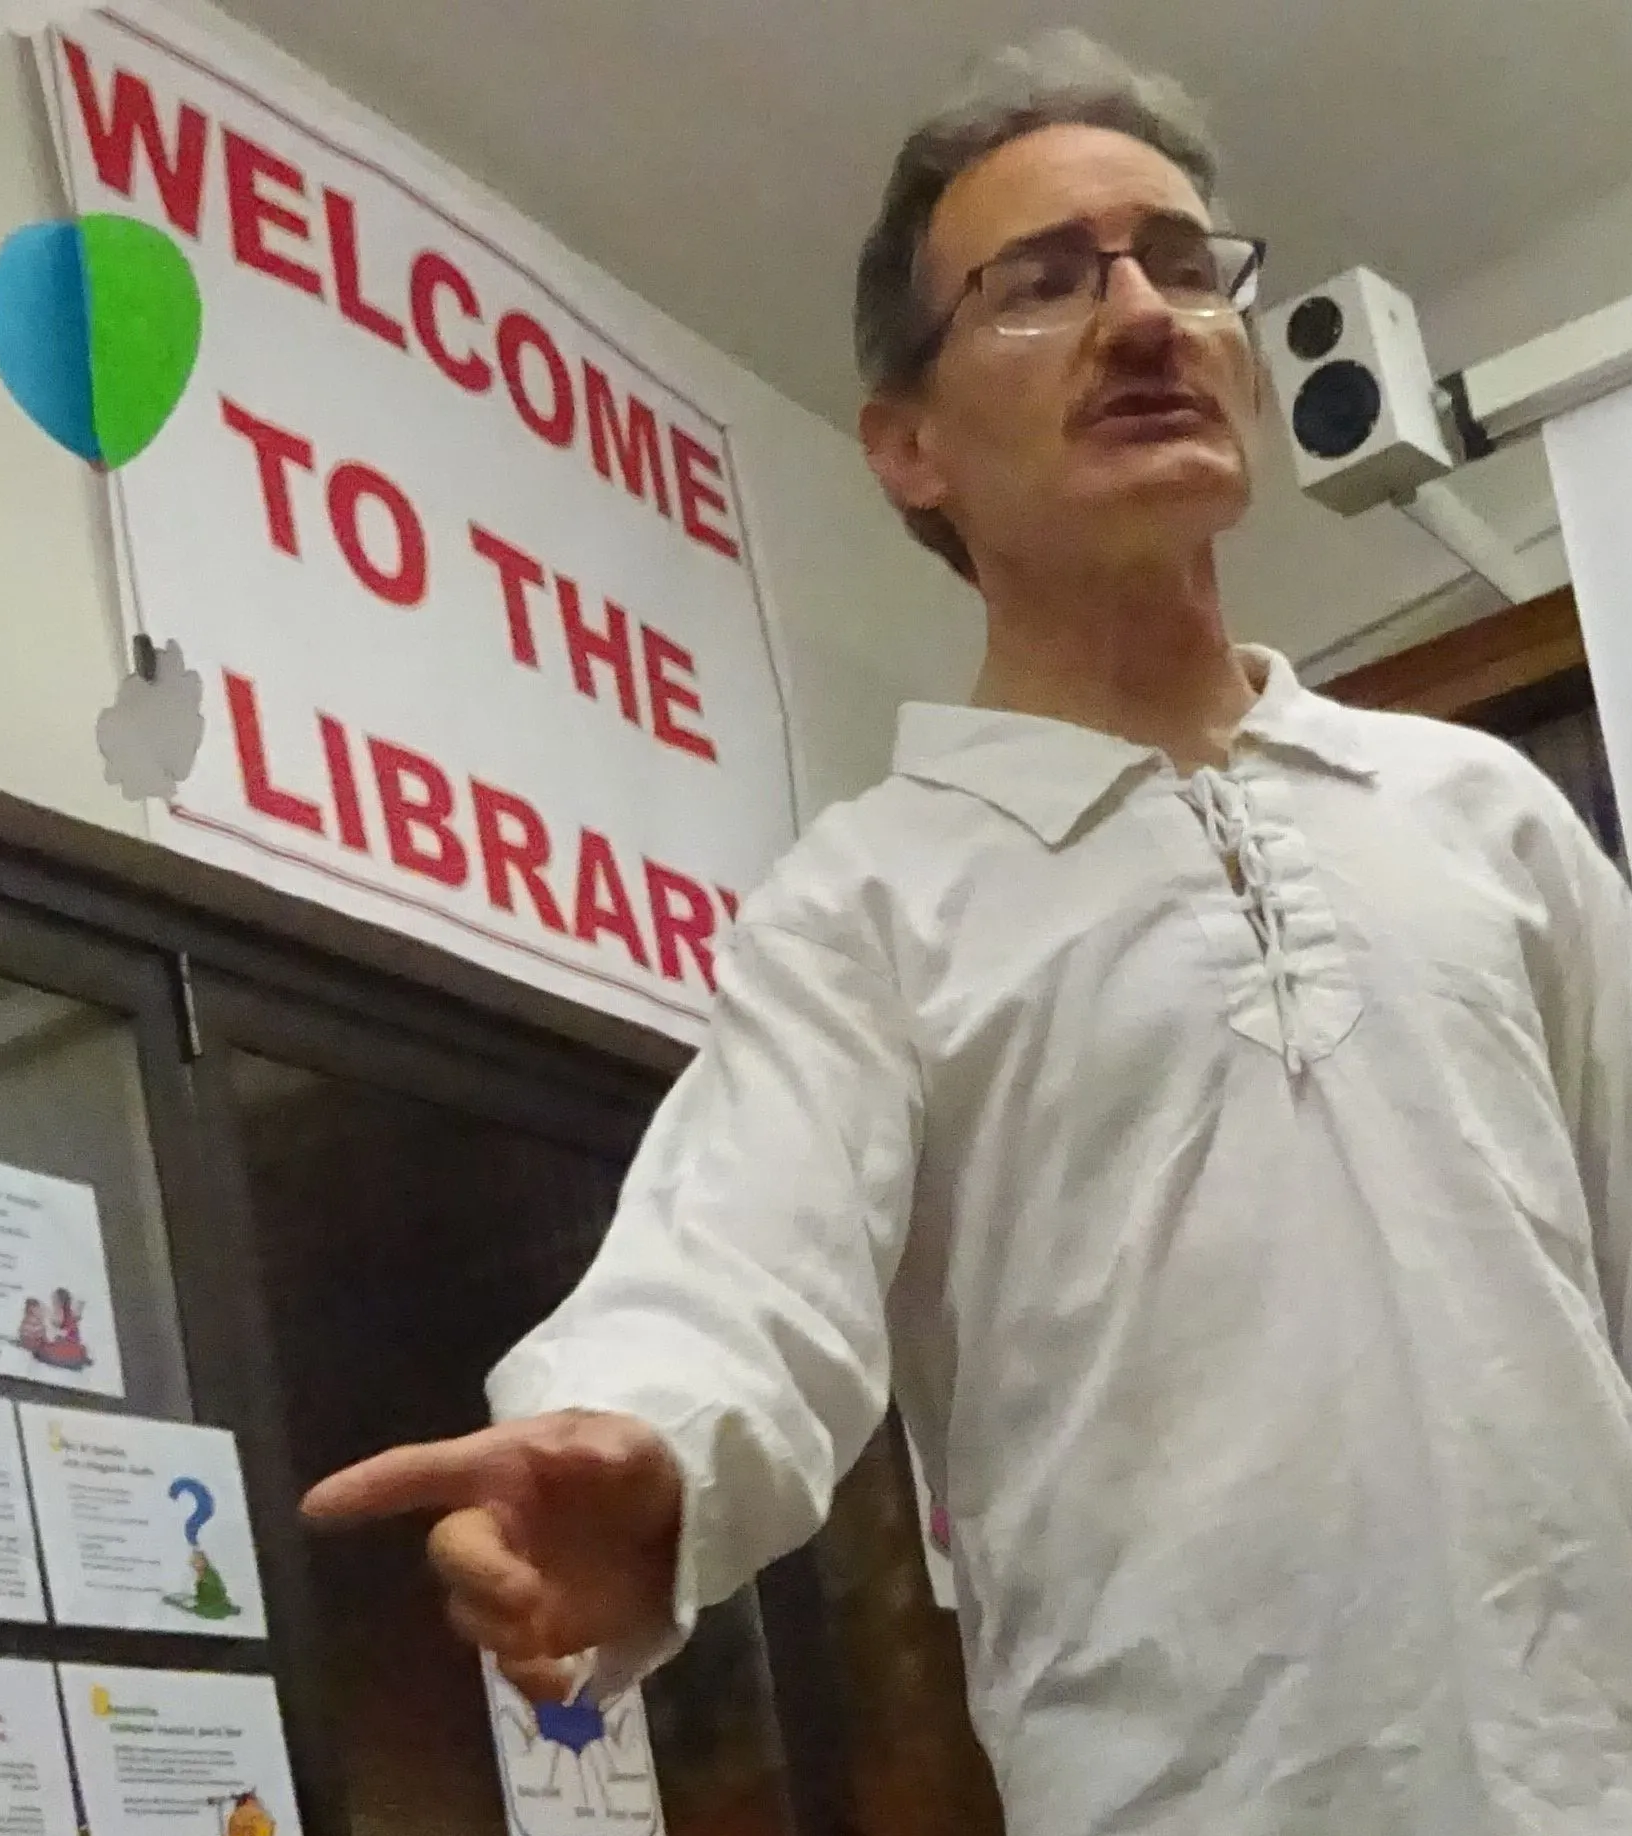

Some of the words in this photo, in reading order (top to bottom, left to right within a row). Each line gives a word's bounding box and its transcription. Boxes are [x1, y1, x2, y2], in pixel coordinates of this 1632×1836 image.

[61, 34, 741, 560] WELCOME
[218, 391, 429, 608] TO
[468, 519, 718, 764] THE
[221, 666, 740, 996] LIBRAR
